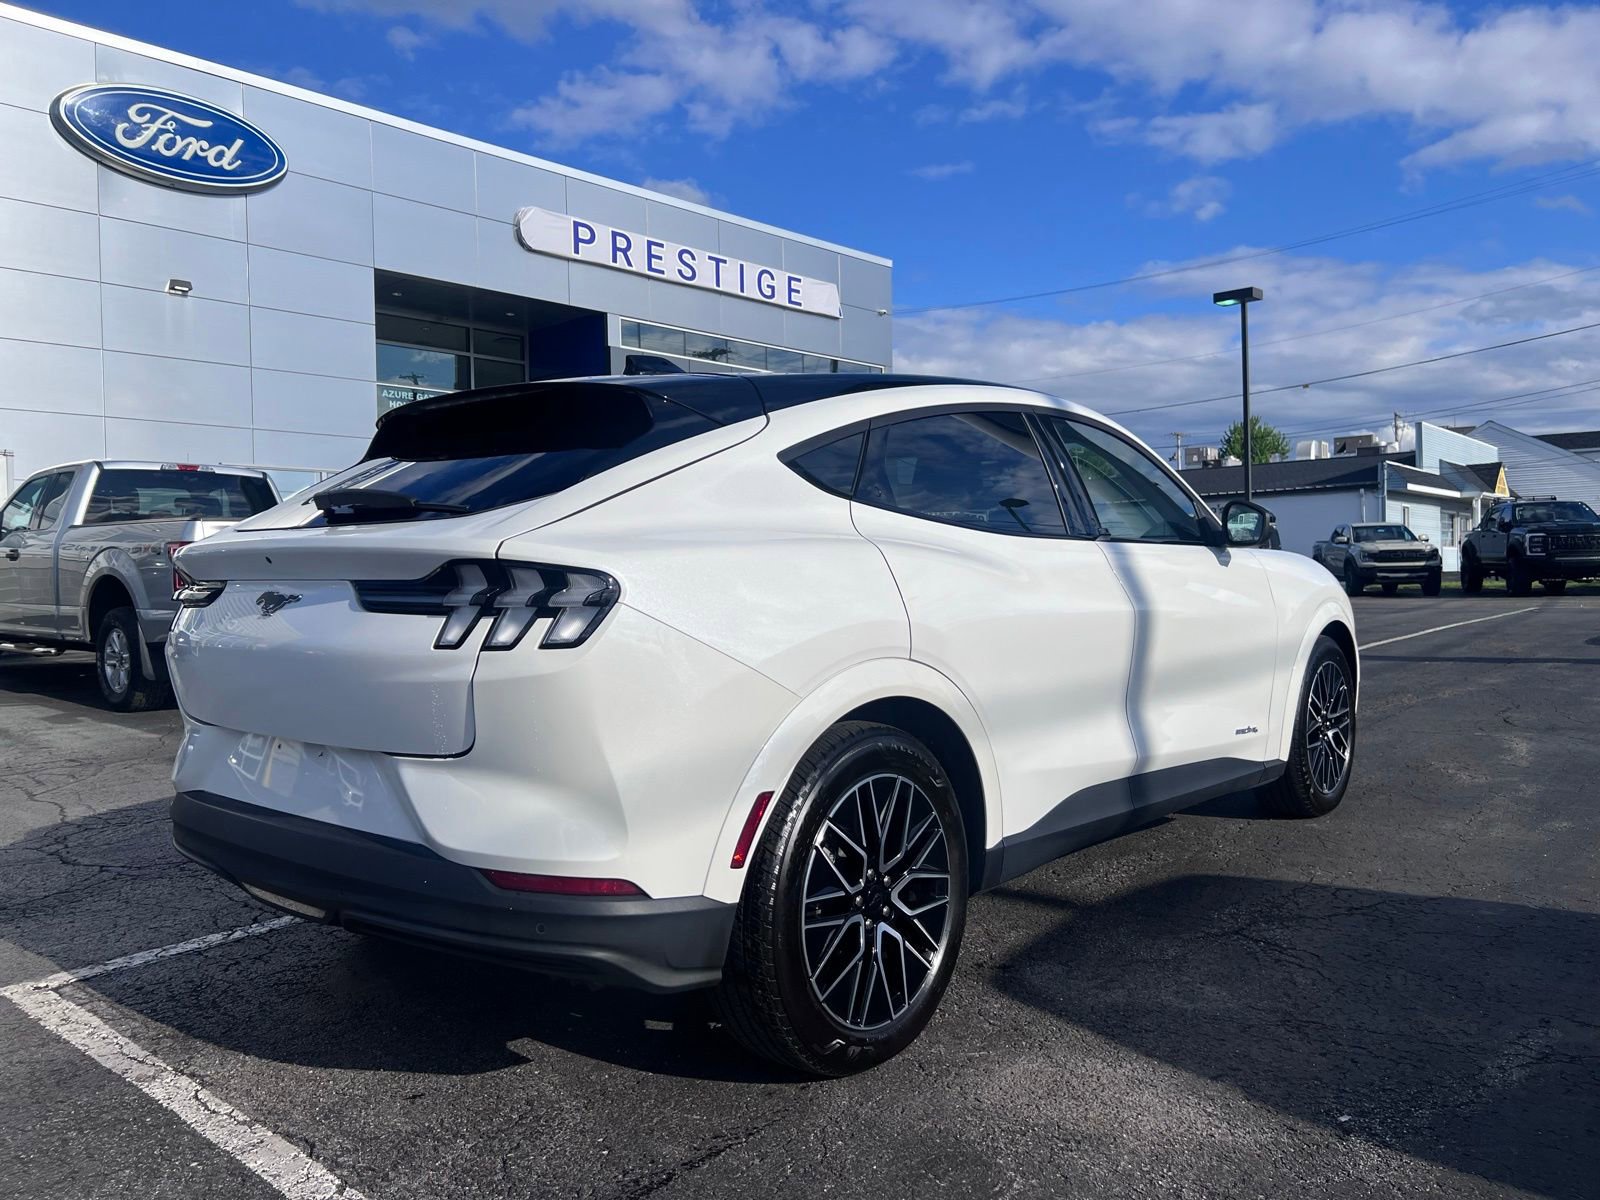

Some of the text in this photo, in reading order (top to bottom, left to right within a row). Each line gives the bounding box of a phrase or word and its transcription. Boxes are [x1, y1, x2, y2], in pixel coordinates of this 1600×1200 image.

[114, 102, 244, 171] Ford
[572, 219, 803, 307] PRESTIGE
[382, 389, 414, 400] AZURE
